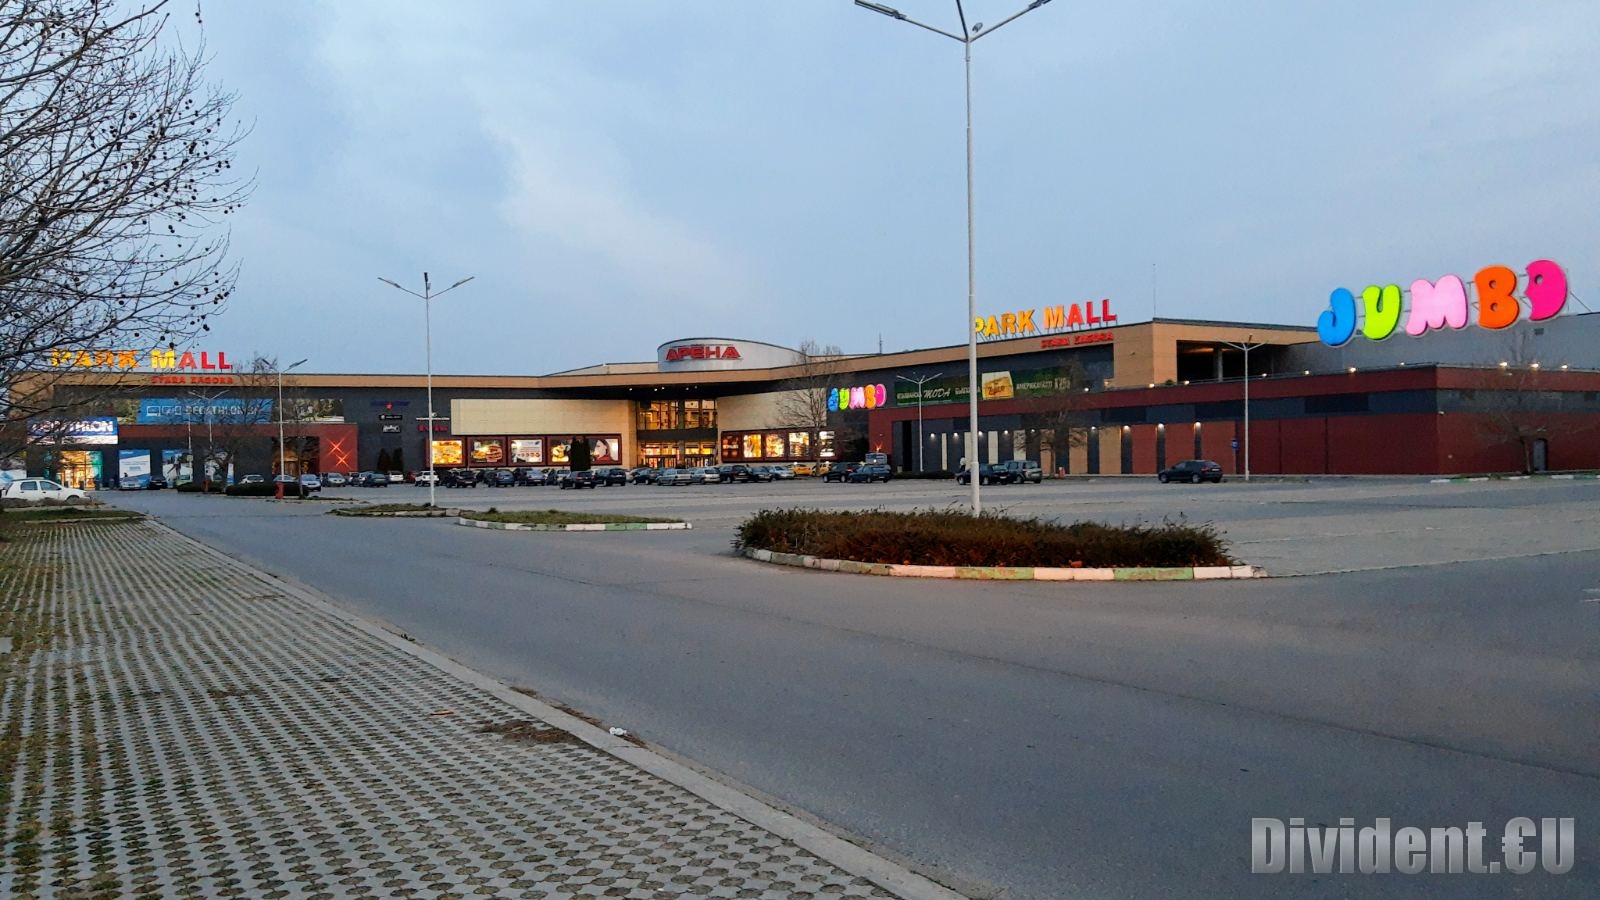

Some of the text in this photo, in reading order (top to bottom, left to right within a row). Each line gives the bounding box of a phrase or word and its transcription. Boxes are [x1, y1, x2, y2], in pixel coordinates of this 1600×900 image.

[1317, 260, 1568, 347] JUMBO
[975, 299, 1118, 337] PARK MALL
[51, 349, 233, 369] PARK MALL
[666, 345, 741, 360] АРЕНА
[827, 383, 886, 412] JUMBO
[32, 420, 114, 432] ECATHLON
